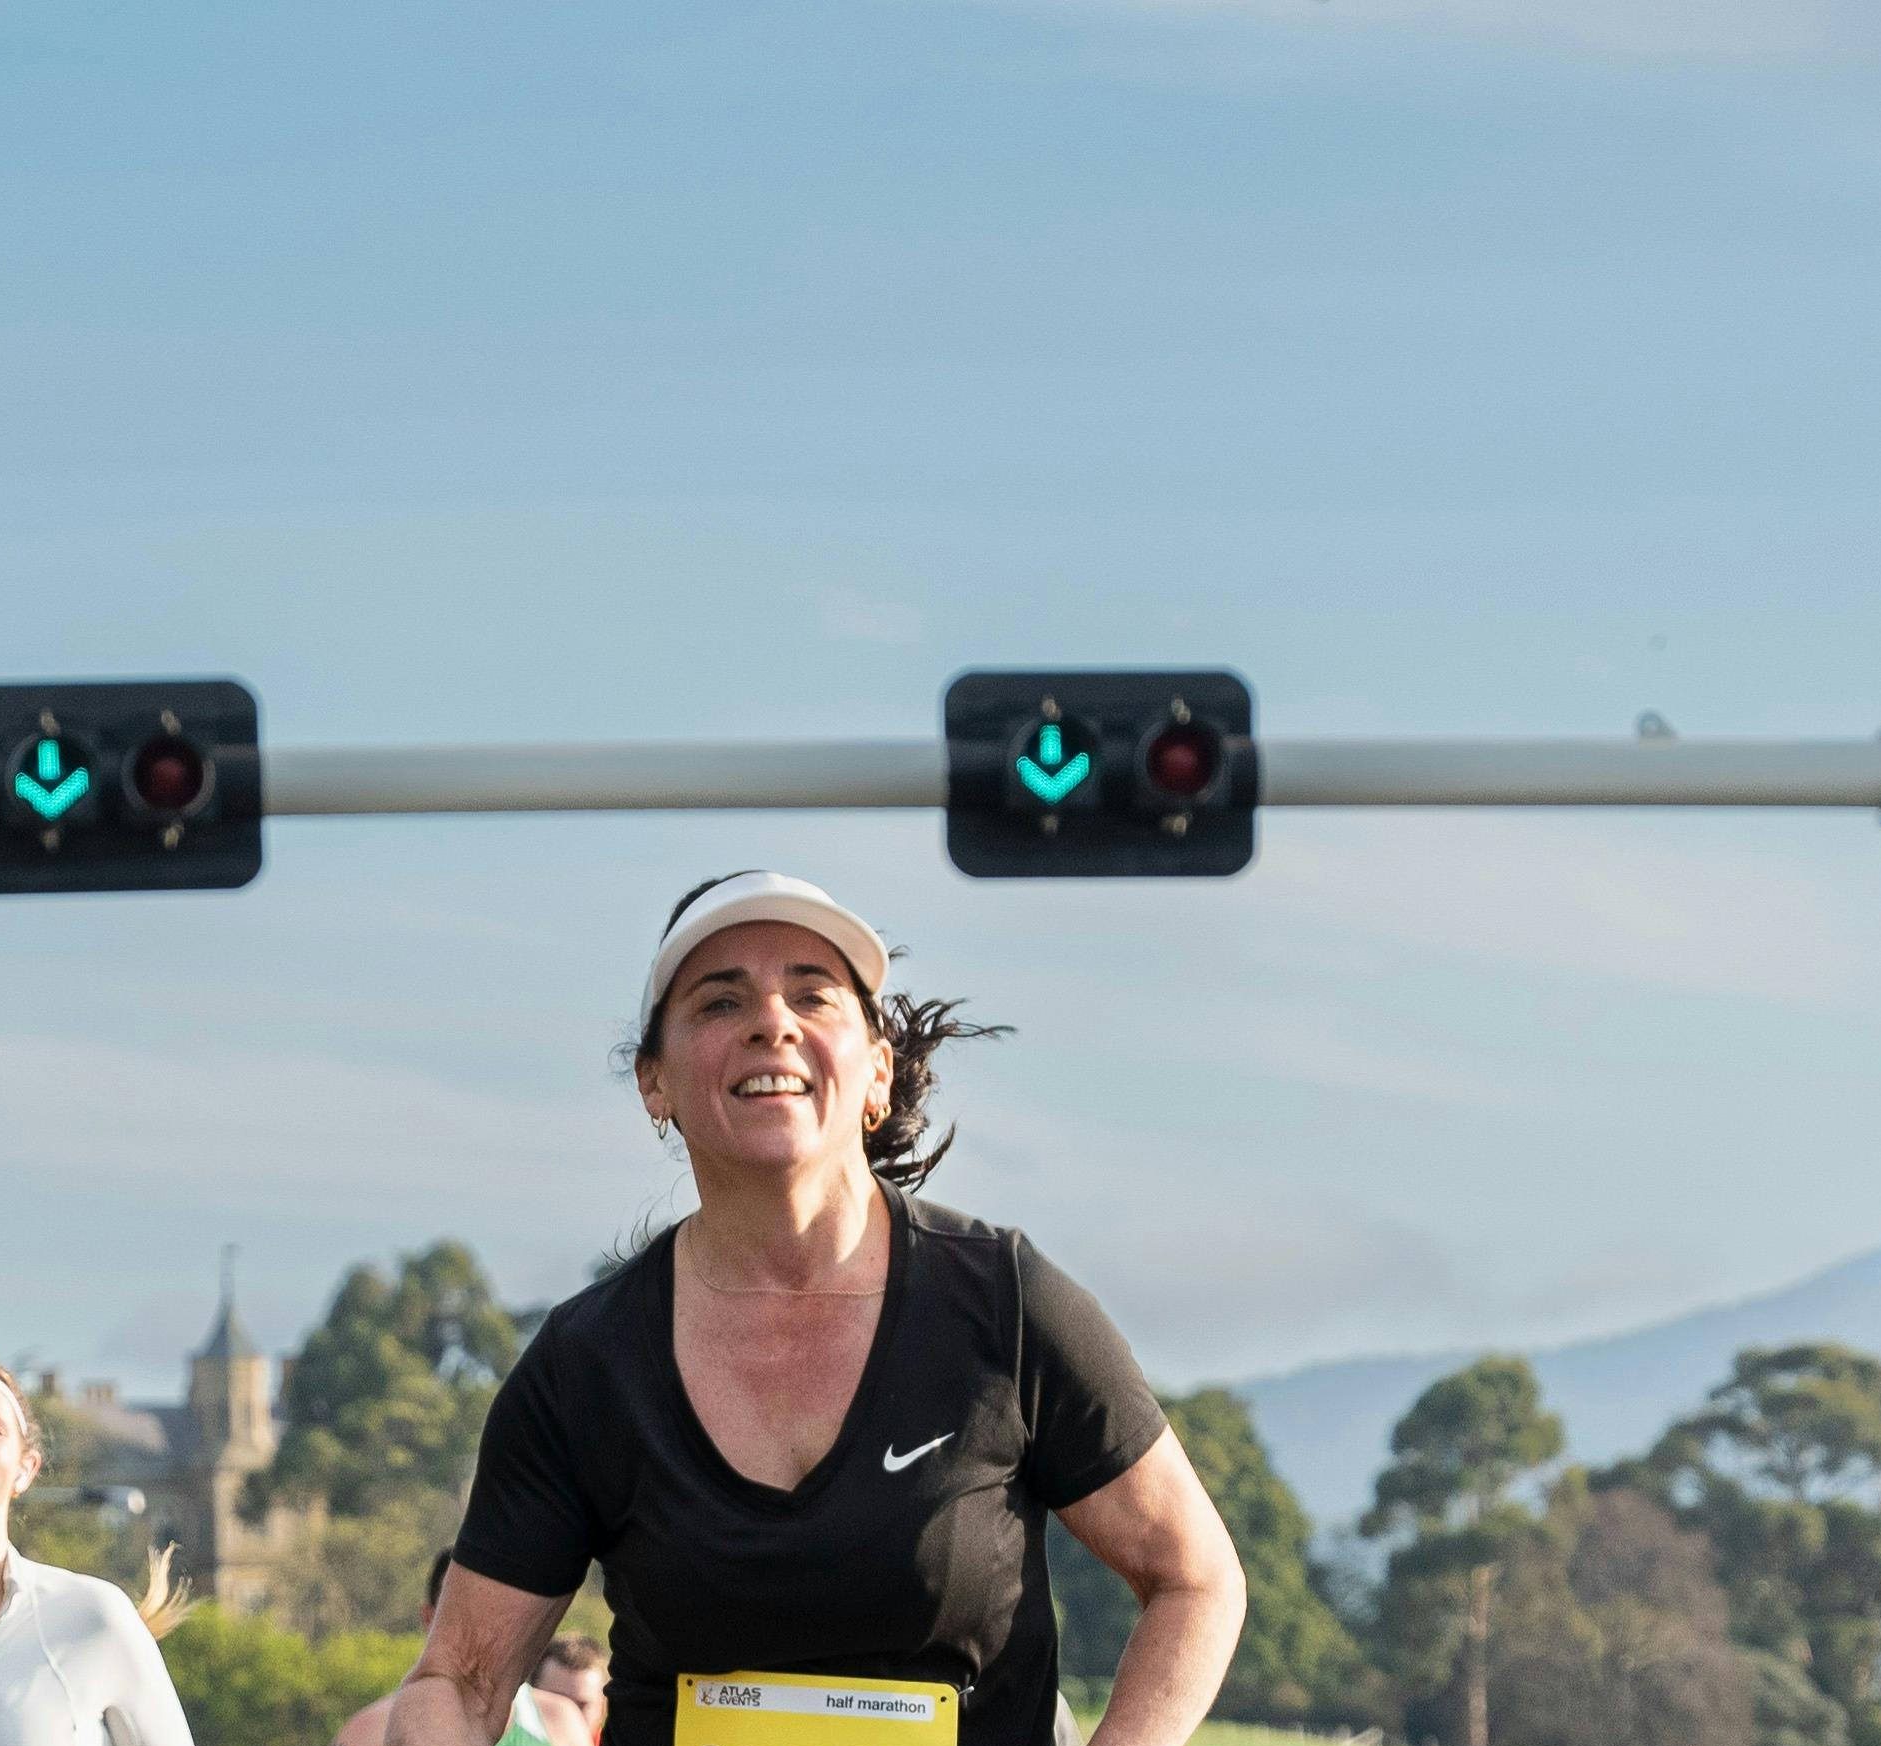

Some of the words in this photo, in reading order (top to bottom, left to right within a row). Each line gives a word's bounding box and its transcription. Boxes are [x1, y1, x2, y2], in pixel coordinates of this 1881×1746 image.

[719, 1685, 761, 1698] ATLAS
[718, 1696, 761, 1707] EVENTS
[825, 1694, 855, 1709] half
[857, 1697, 926, 1715] marathon
